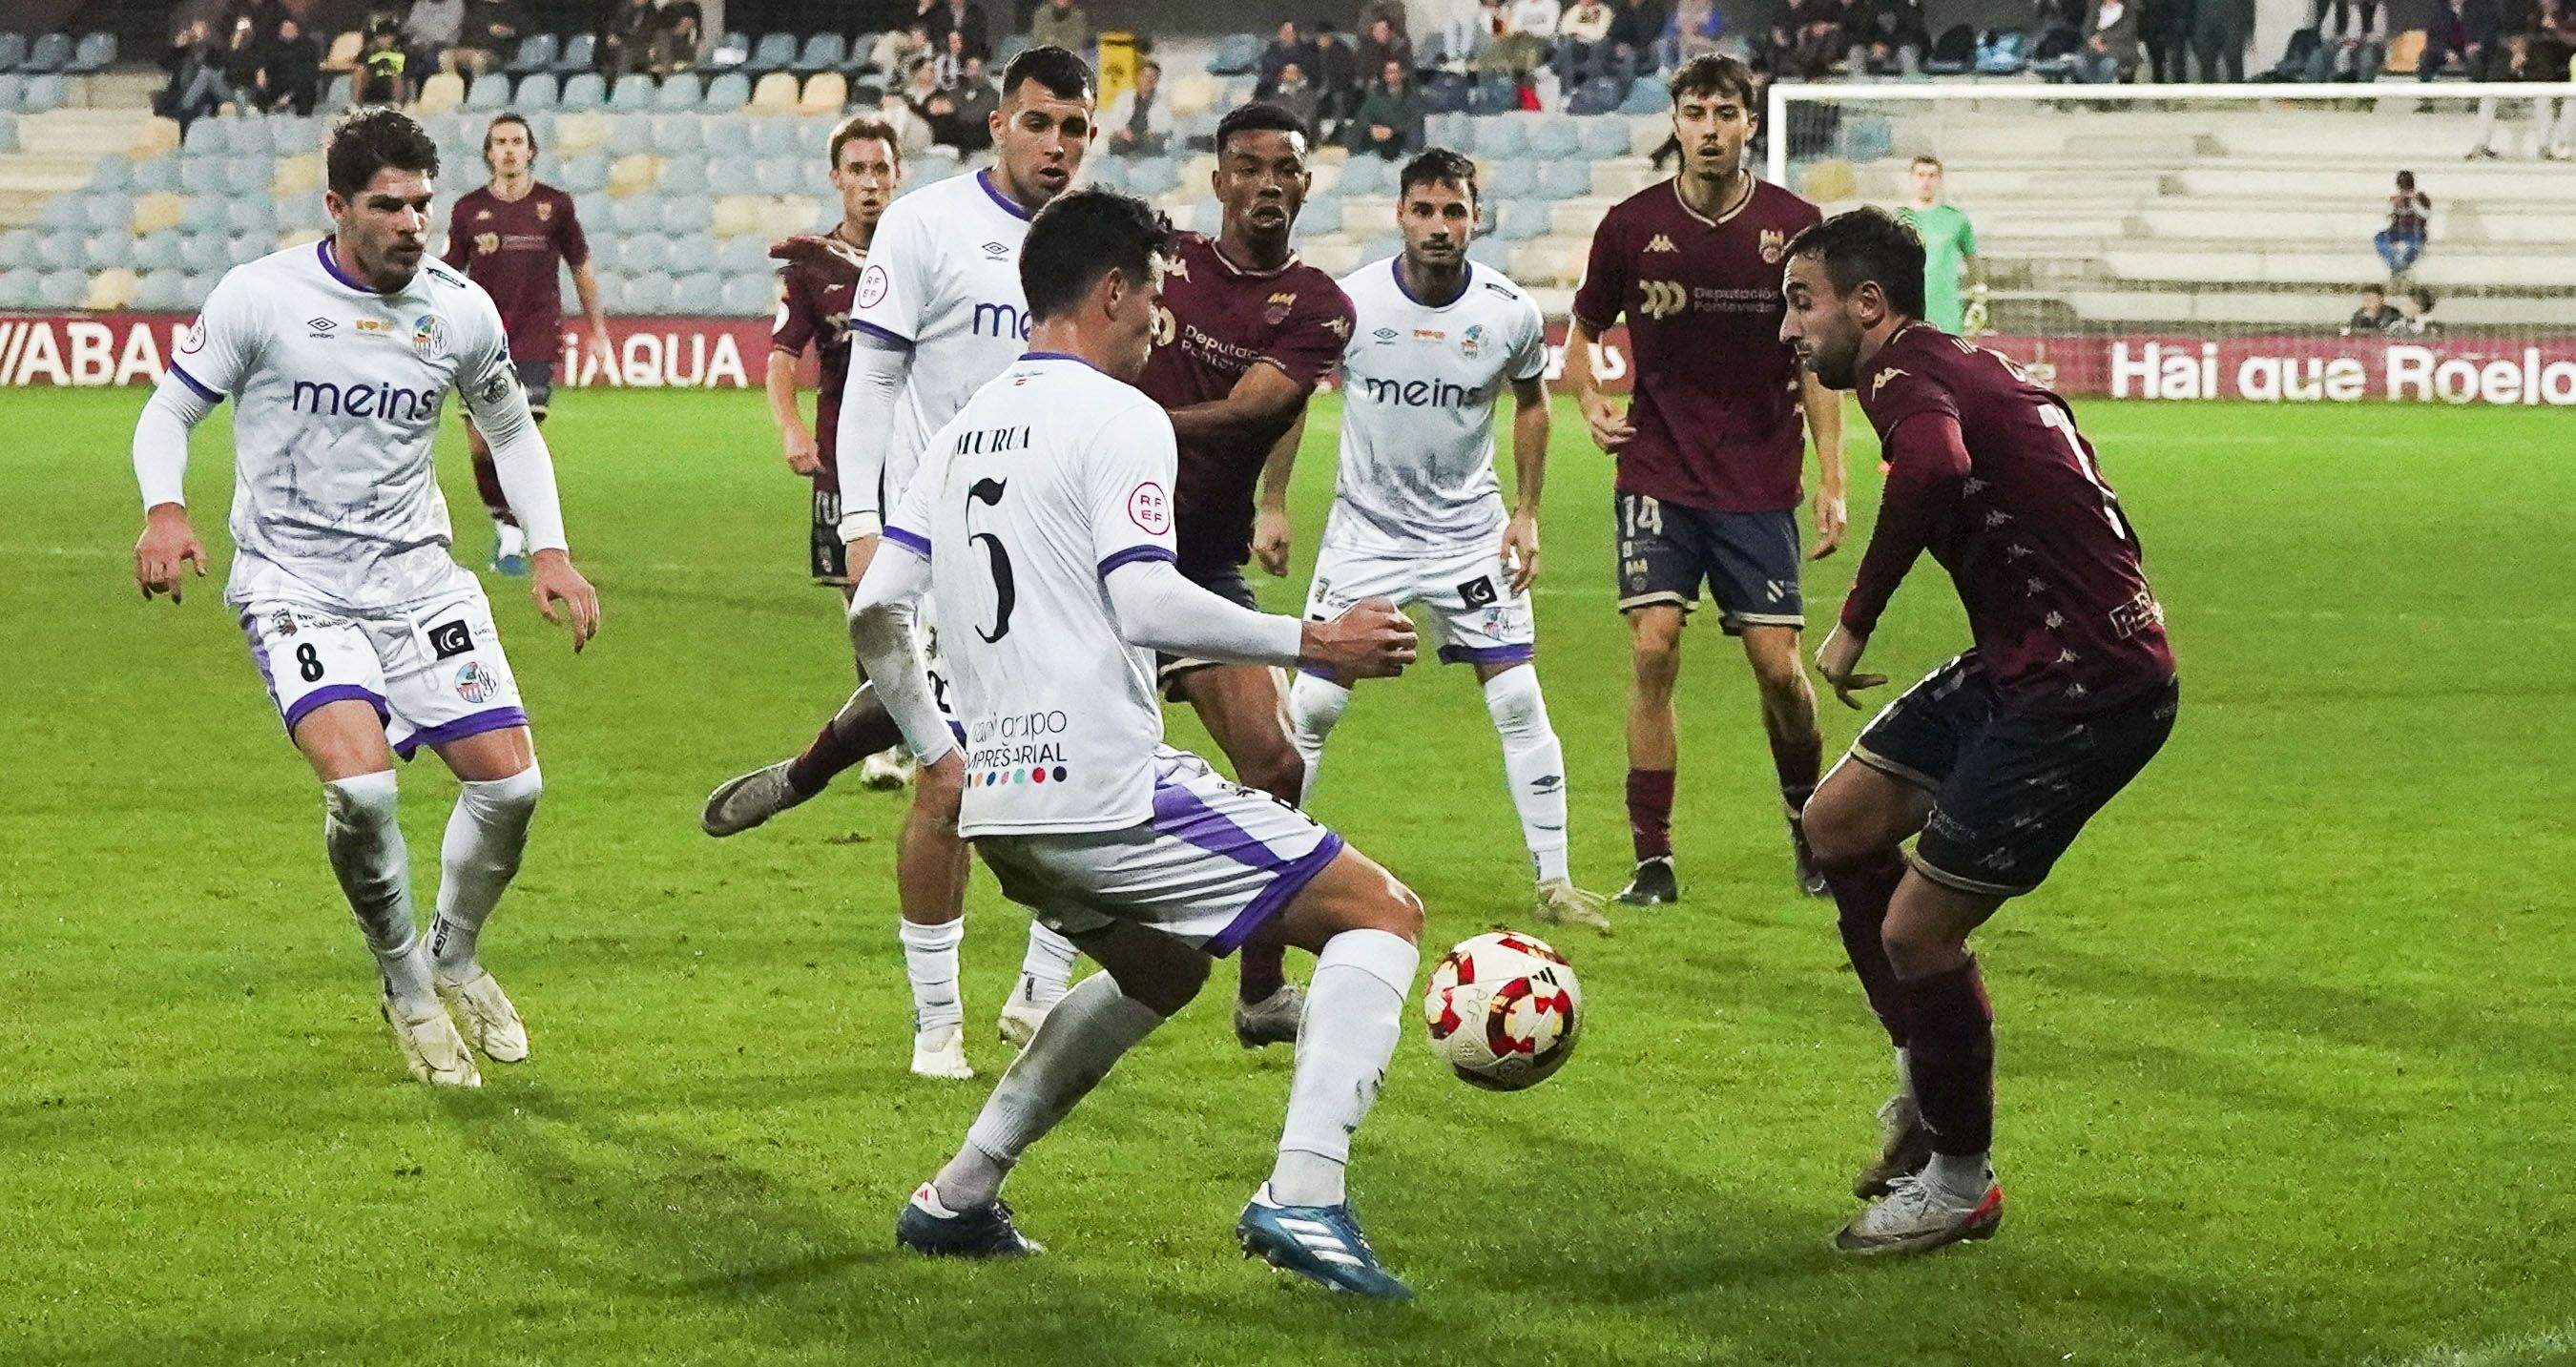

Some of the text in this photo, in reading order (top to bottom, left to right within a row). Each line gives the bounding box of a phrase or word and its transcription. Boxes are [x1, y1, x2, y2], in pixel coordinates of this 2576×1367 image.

[2111, 342, 2218, 399] Hai
[2387, 344, 2576, 405] Roelo
[292, 380, 439, 421] meins
[955, 425, 1030, 455] MURUA
[1624, 494, 1663, 538] 14
[966, 477, 1015, 644] 5
[296, 642, 325, 682] 8
[1001, 711, 1067, 746] grupo
